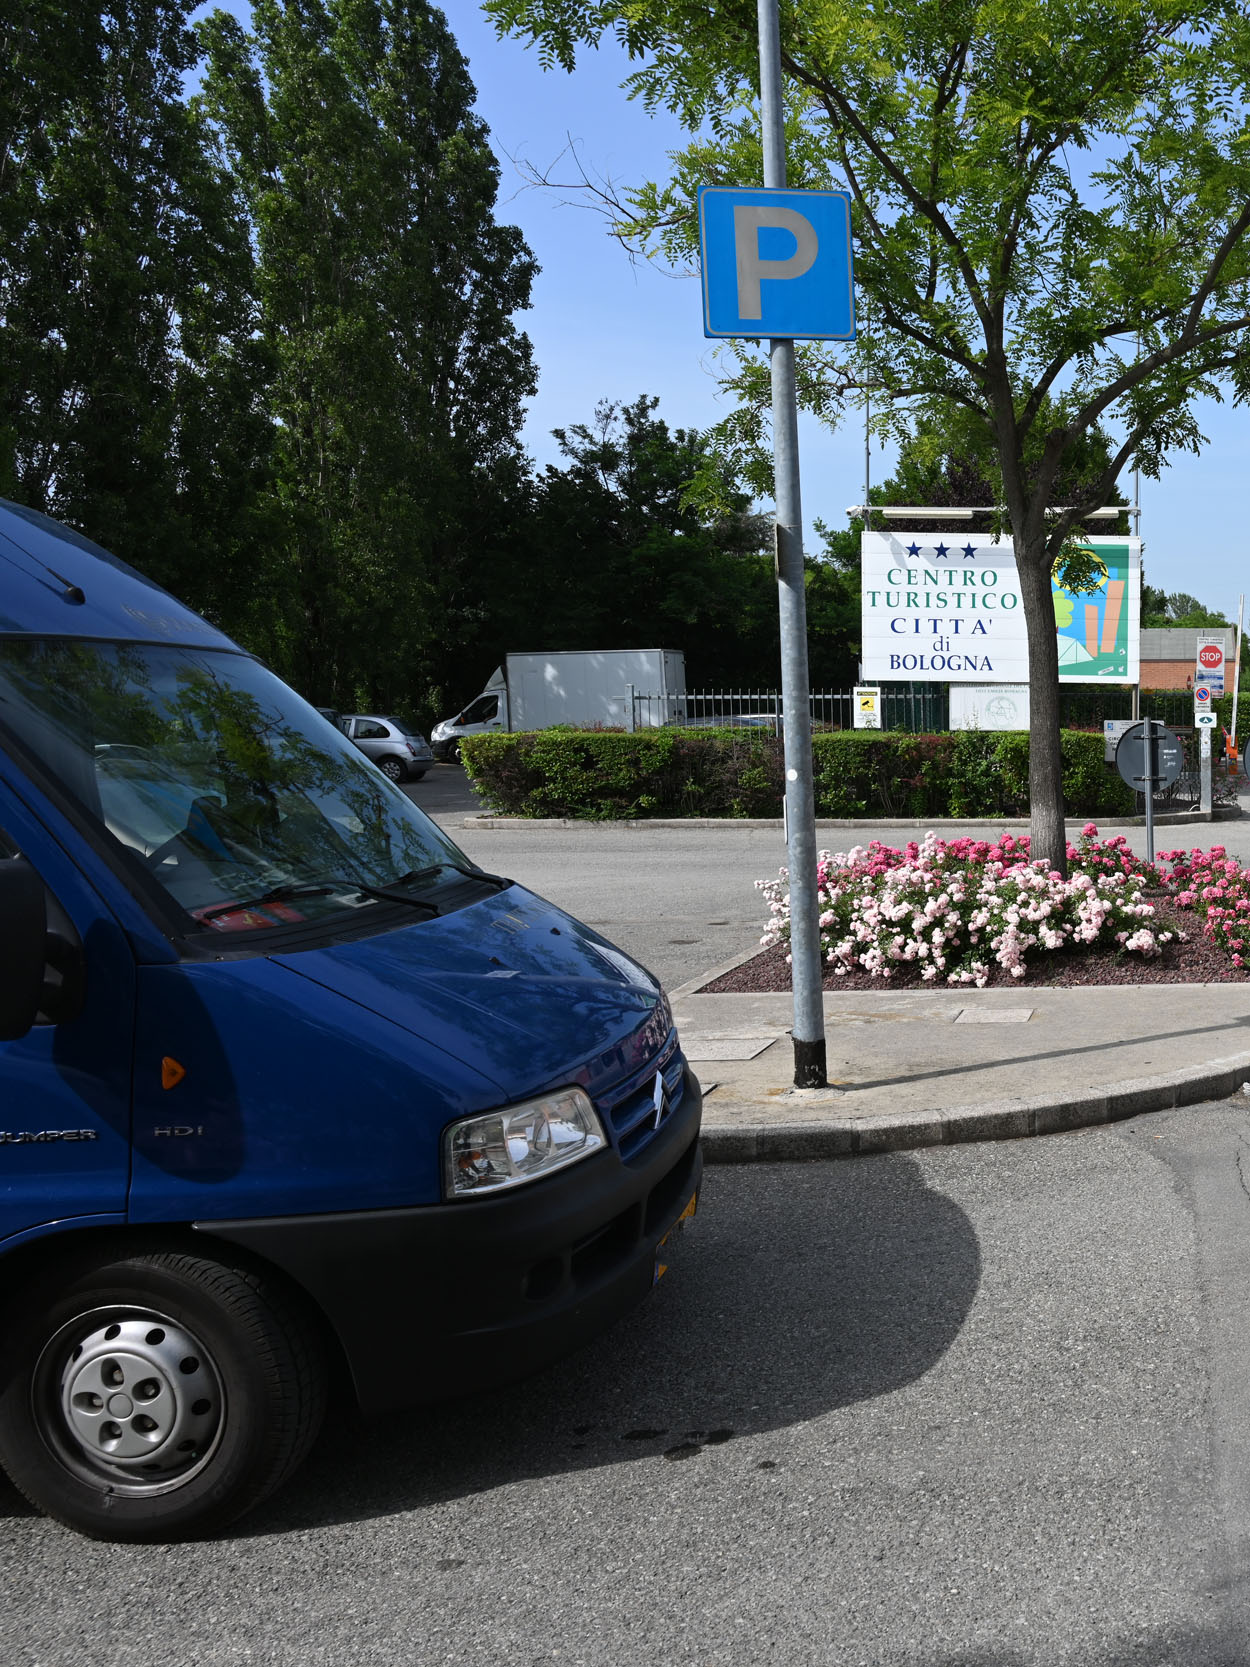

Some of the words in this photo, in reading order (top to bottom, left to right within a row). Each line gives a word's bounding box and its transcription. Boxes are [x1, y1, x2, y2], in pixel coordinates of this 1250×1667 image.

[734, 206, 818, 320] P
[887, 569, 998, 587] CENTRO
[867, 591, 1018, 610] TURISTICO
[890, 618, 993, 635] CITTA'
[932, 636, 951, 652] di
[889, 655, 994, 672] BOLOGNA
[1200, 651, 1221, 662] STOP
